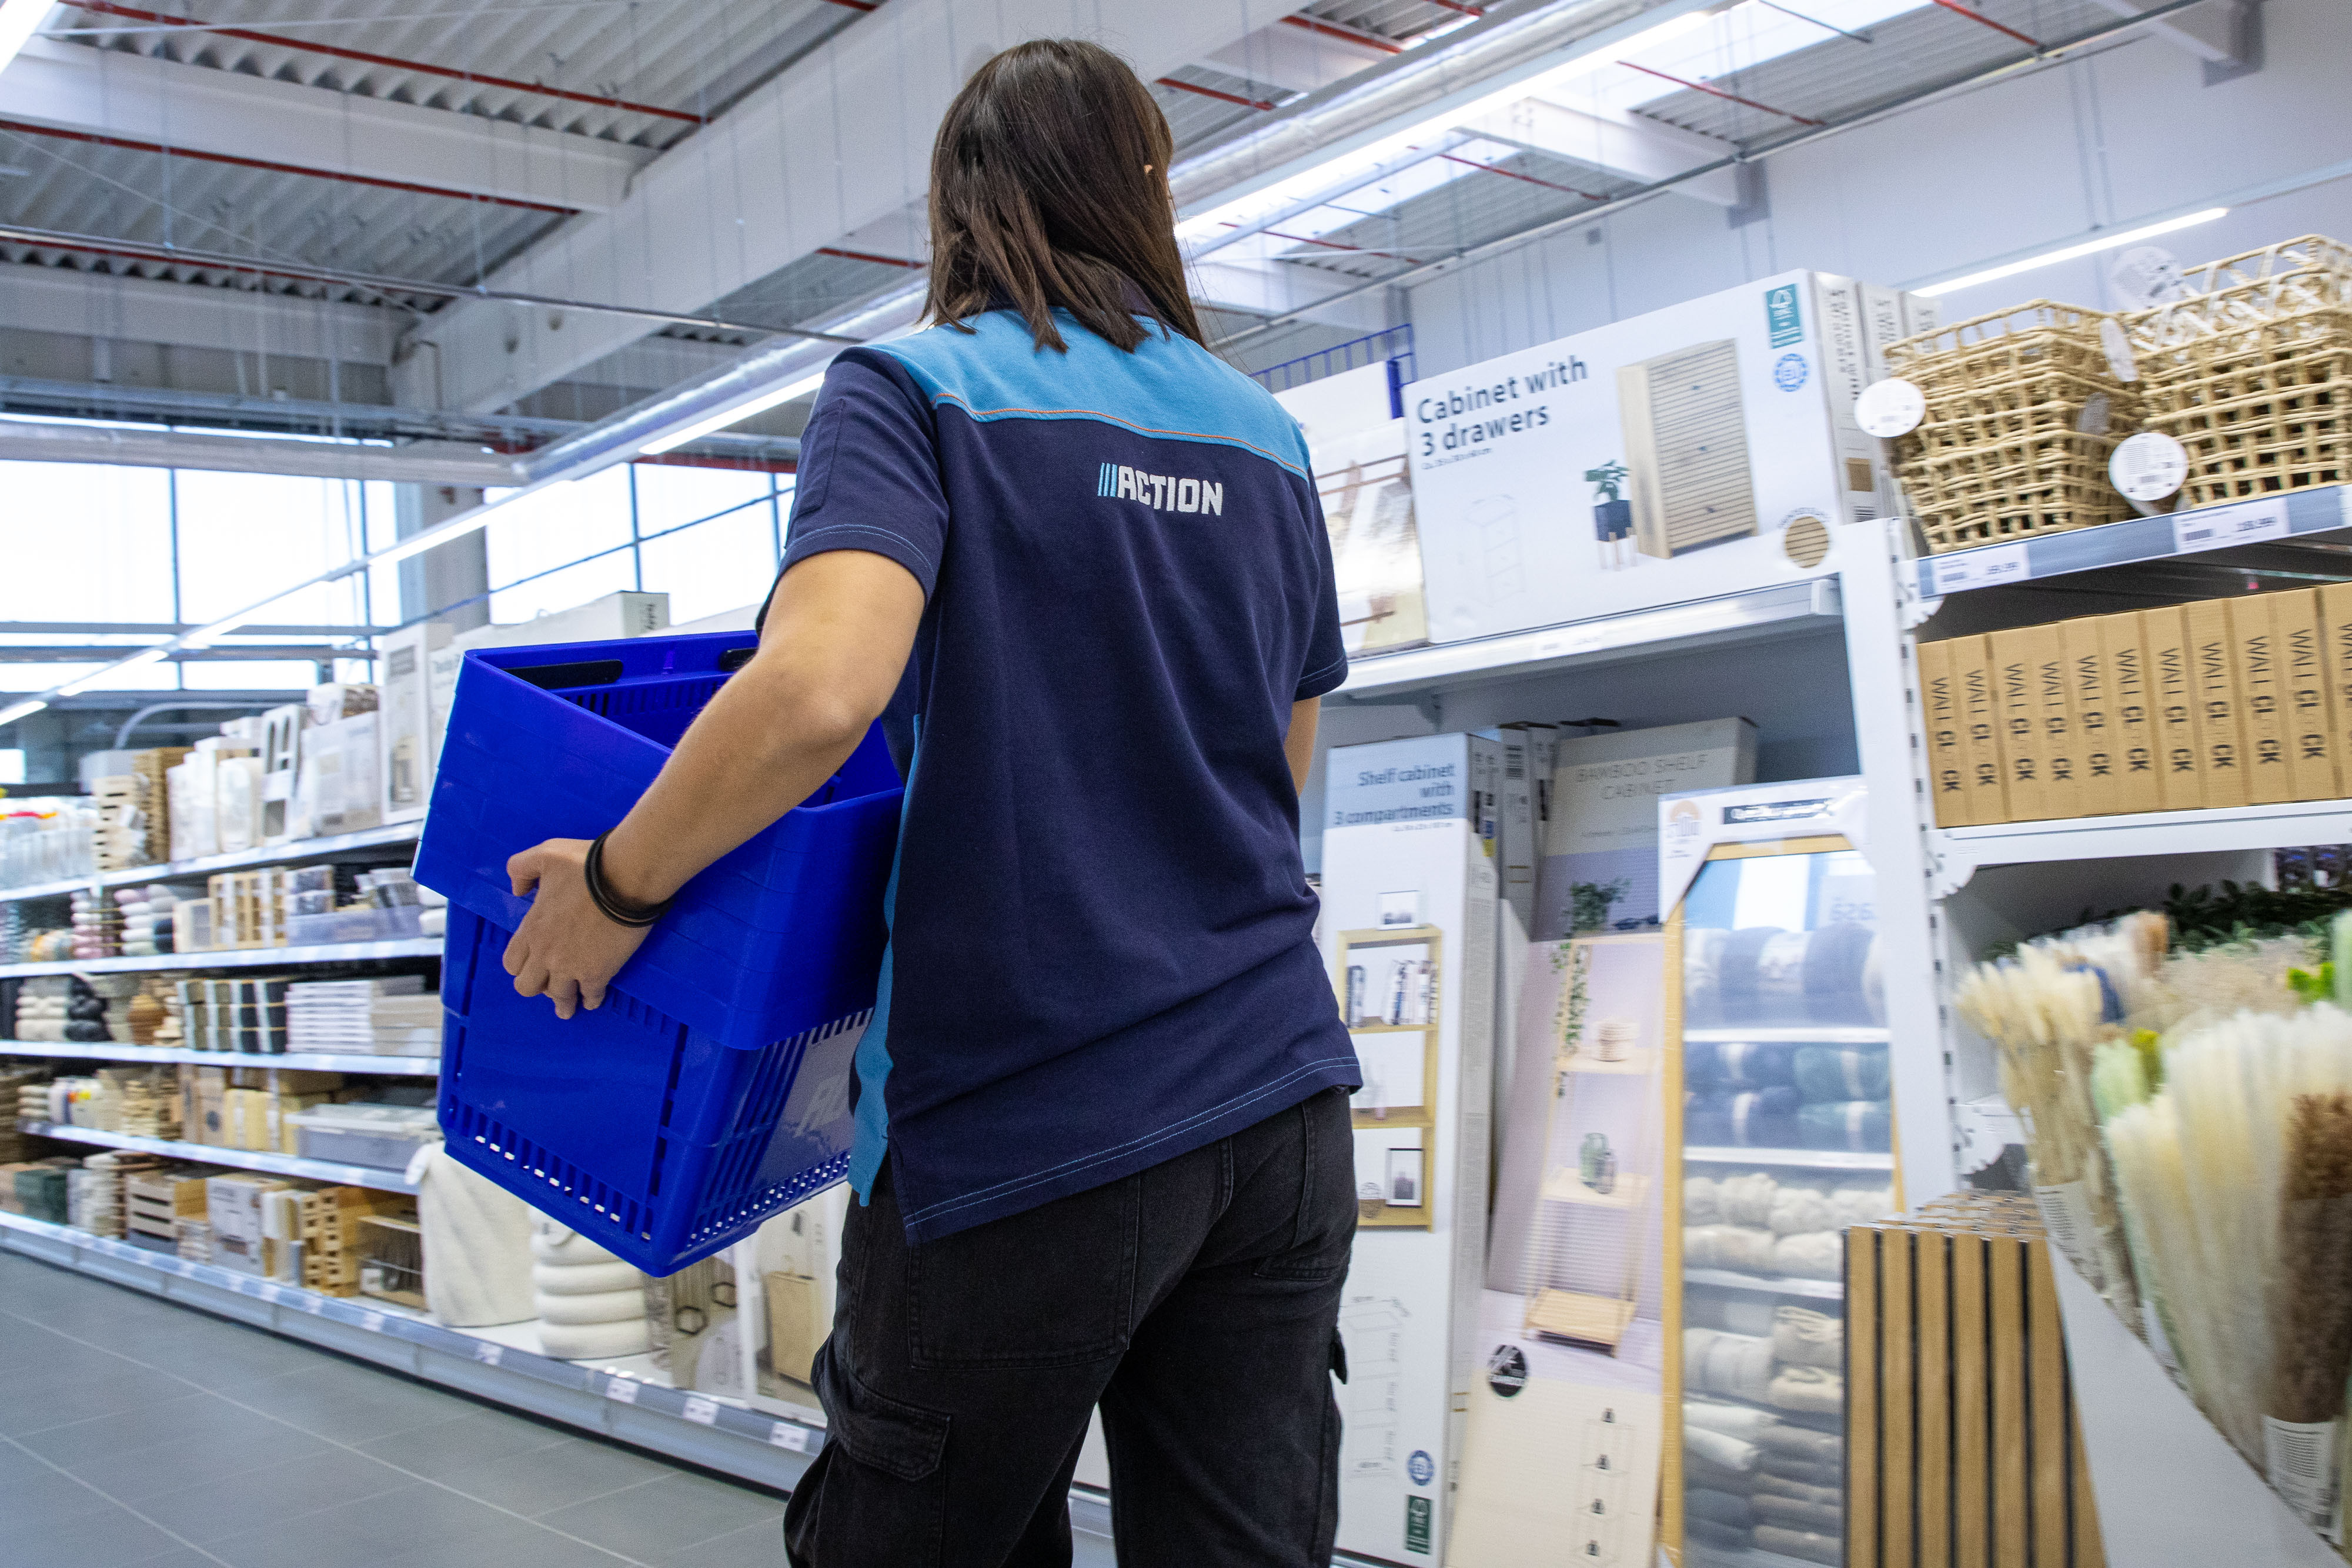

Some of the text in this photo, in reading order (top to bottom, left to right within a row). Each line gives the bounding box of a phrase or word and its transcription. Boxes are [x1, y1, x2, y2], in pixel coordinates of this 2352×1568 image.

[1417, 355, 1588, 423] Cabinet with
[1420, 406, 1549, 456] 3 drawers
[1118, 466, 1223, 516] ACTION
[1970, 724, 1997, 785] CLCK
[2008, 718, 2037, 781] CLCK
[2044, 717, 2073, 780] CLCK
[2082, 712, 2112, 777] CLCK
[2121, 706, 2151, 772] CLCK
[2164, 706, 2194, 772] CLCK
[2206, 701, 2234, 768] CLCK
[2251, 696, 2283, 764] CLCK
[2293, 690, 2327, 760] CLCK
[1358, 767, 1397, 786] Shelf
[1398, 764, 1455, 781] cabinet
[1419, 781, 1454, 798] with
[1935, 731, 1962, 792] CLCK
